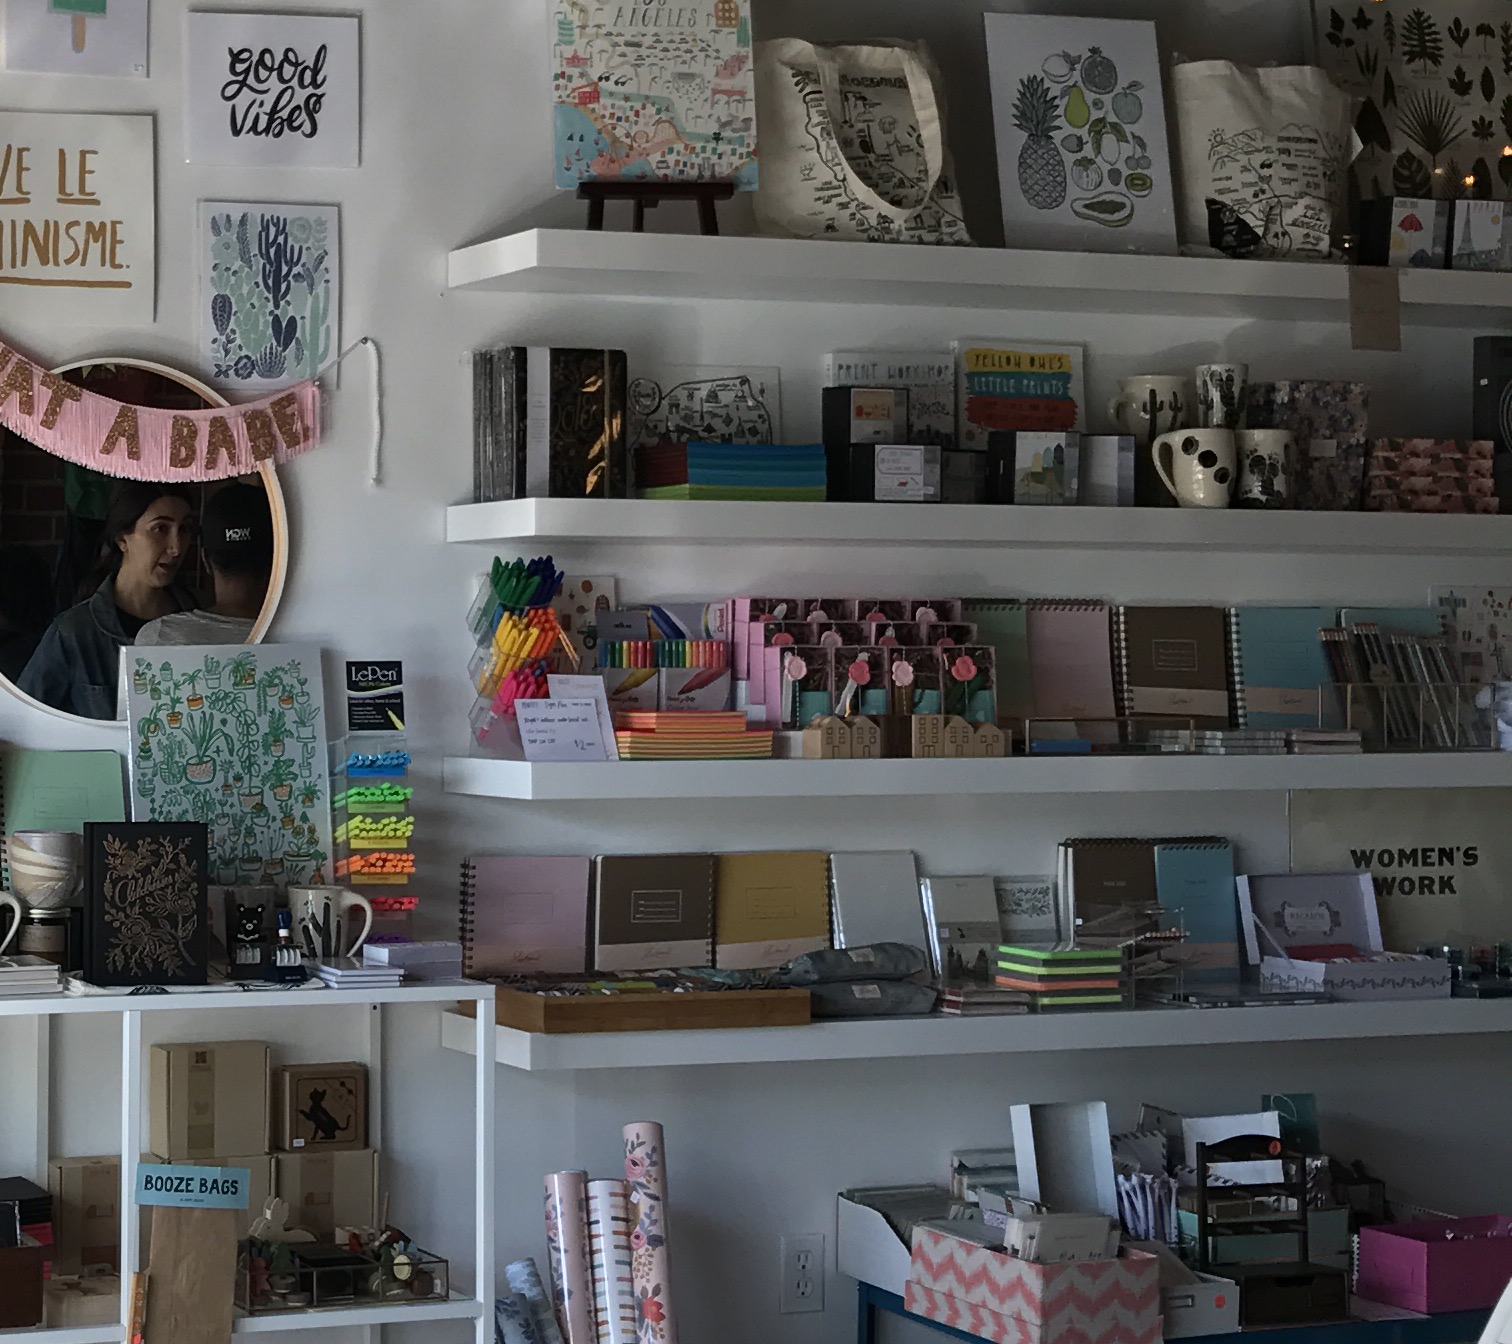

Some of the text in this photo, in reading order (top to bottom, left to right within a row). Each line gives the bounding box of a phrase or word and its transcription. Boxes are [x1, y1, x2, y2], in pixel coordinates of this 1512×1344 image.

[613, 7, 698, 28] ANGELES
[57, 148, 100, 197] LE
[974, 353, 1021, 369] YELLOW
[837, 363, 878, 381] PRINT
[974, 376, 1063, 395] LITTLE PRINTS
[100, 404, 141, 461] A
[169, 394, 310, 470] BABE
[351, 666, 397, 681] LePen
[1350, 846, 1479, 869] WOMEN'S
[1373, 875, 1457, 897] WORK
[144, 1174, 239, 1195] BOOZE BAGS
